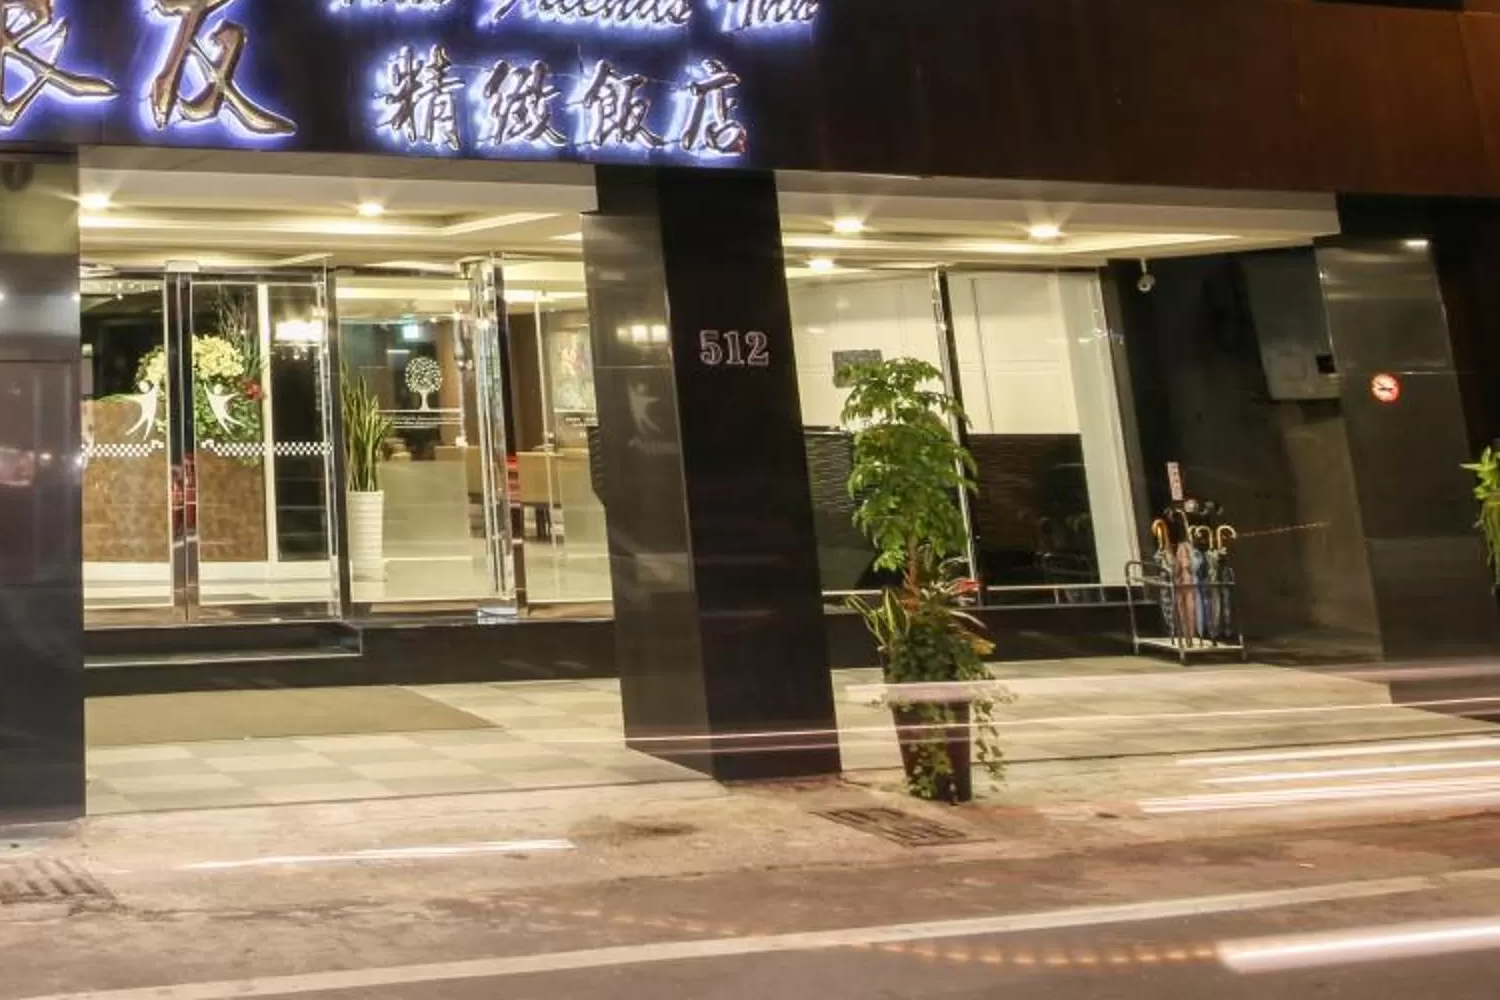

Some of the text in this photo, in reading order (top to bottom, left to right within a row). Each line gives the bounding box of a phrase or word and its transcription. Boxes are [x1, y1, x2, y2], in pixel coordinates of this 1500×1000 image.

[374, 43, 748, 156] 精緻飯店
[699, 329, 769, 366] 512
